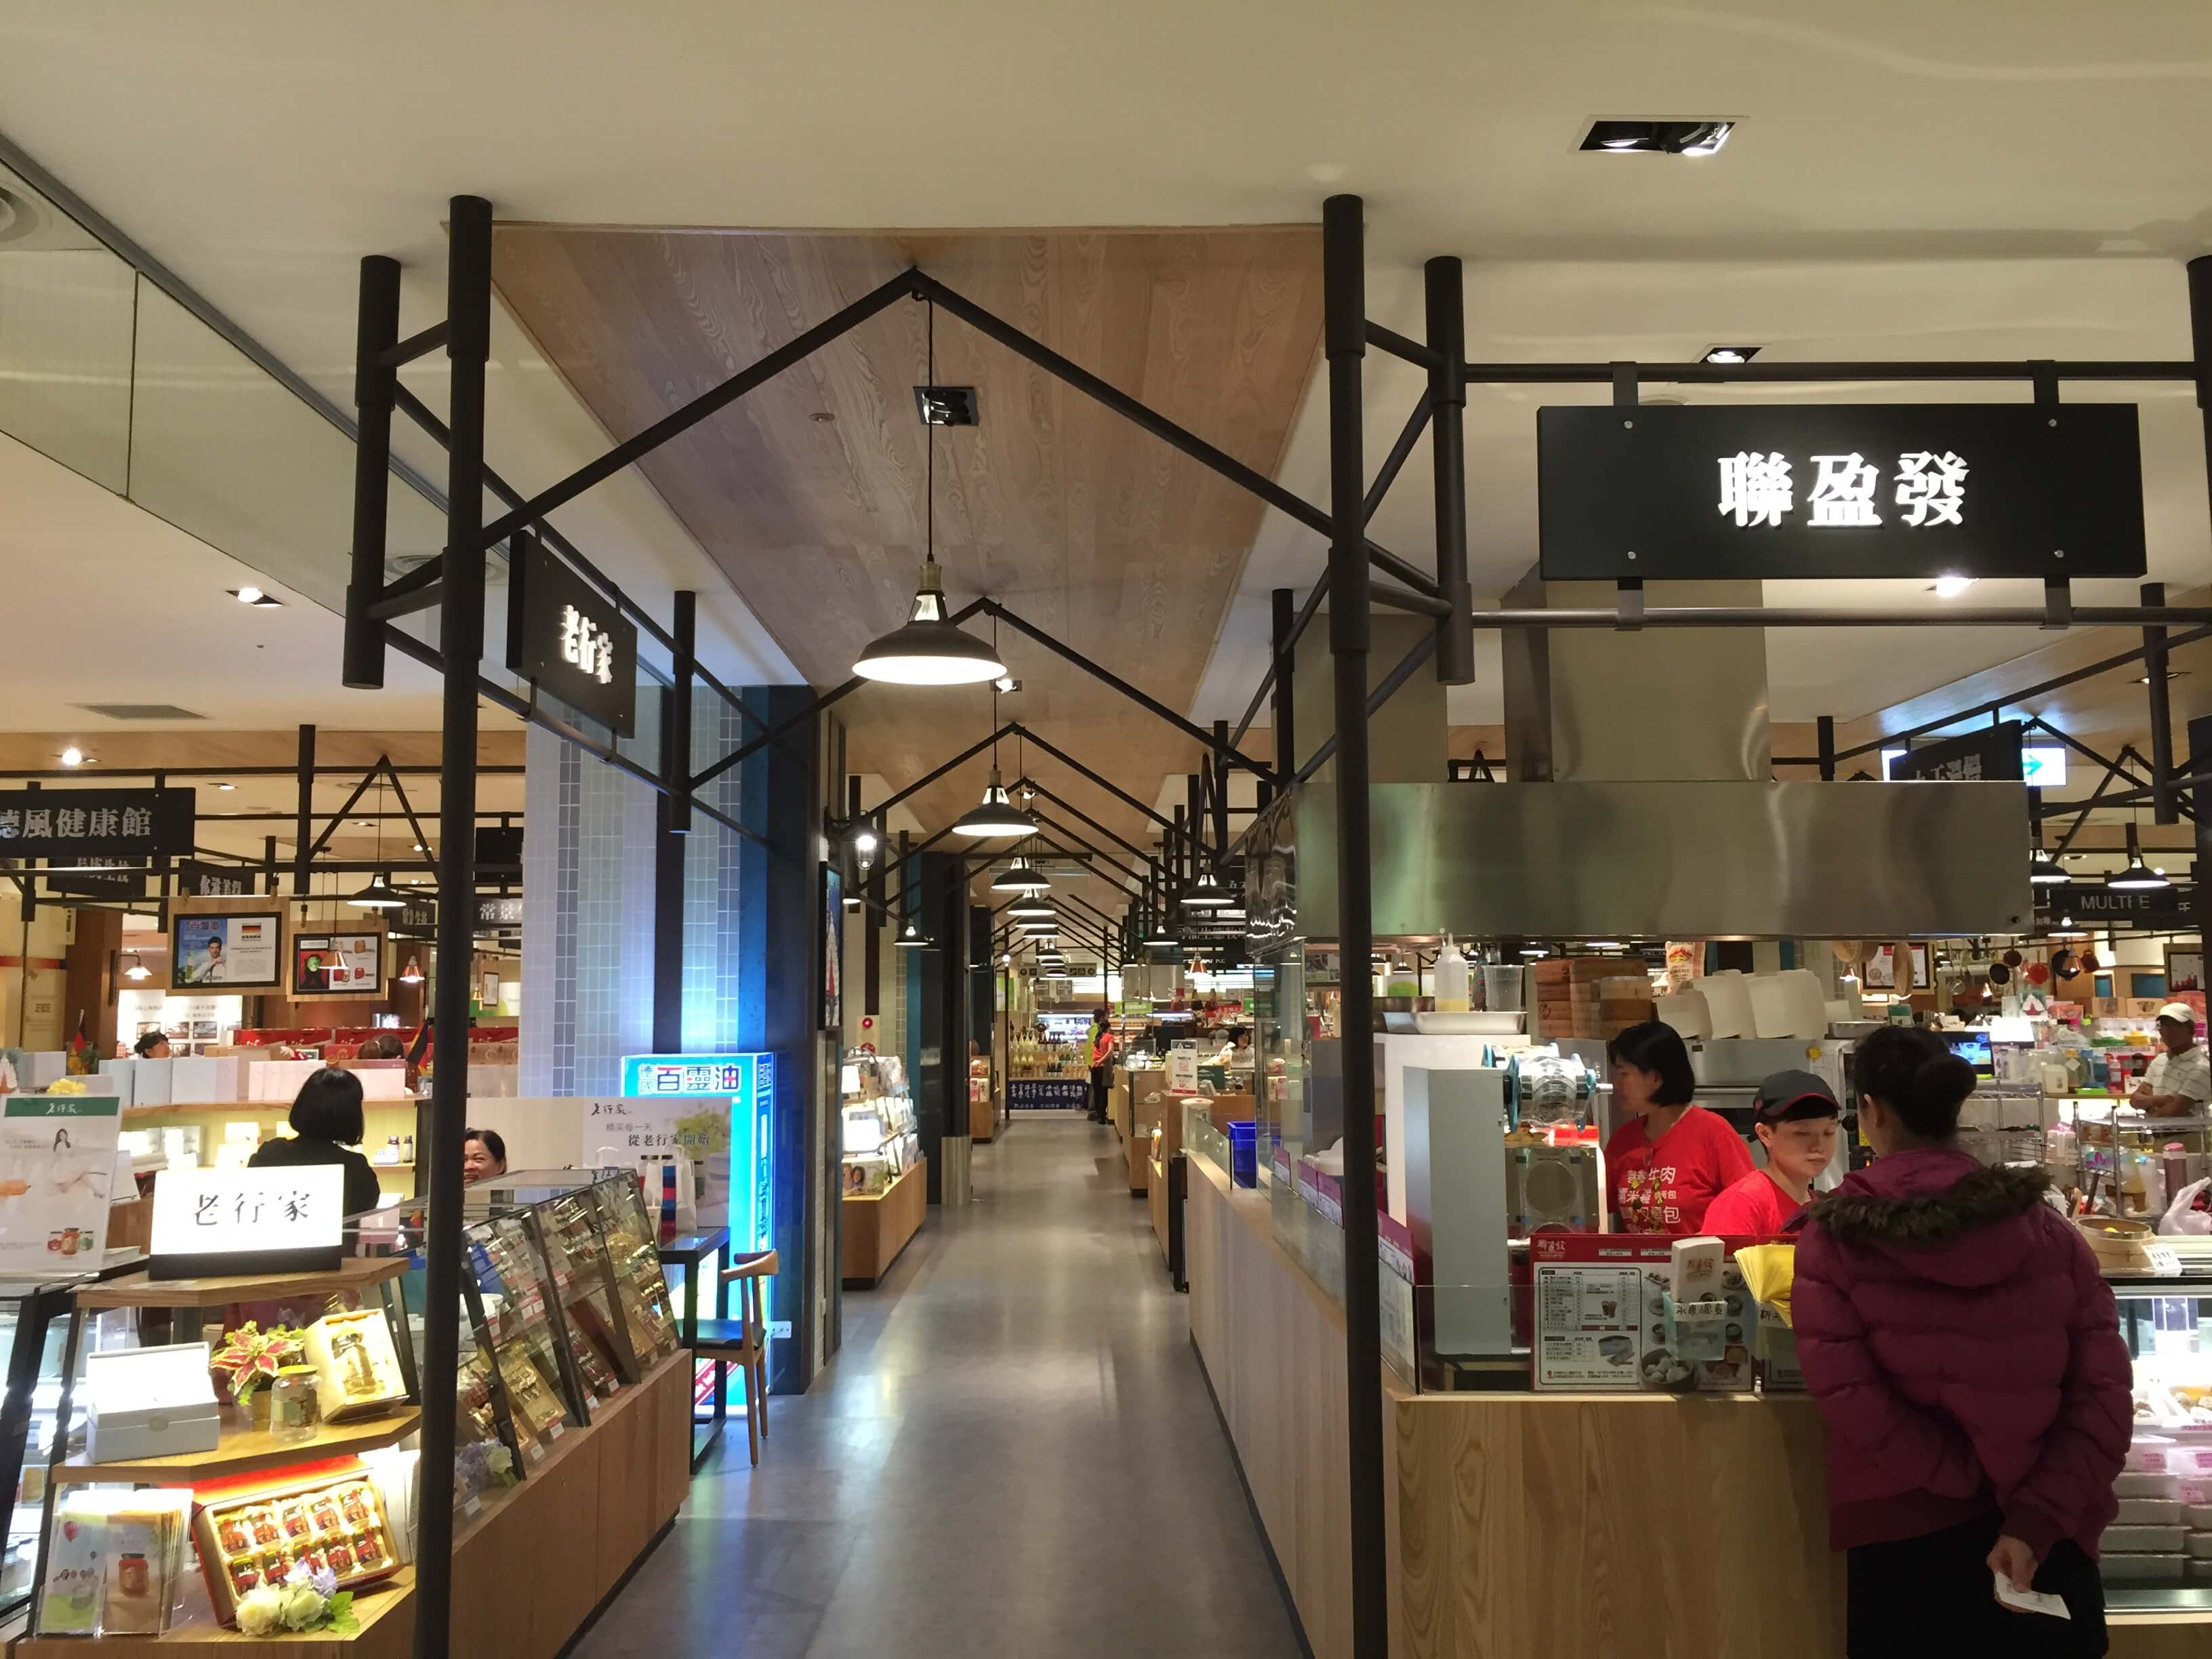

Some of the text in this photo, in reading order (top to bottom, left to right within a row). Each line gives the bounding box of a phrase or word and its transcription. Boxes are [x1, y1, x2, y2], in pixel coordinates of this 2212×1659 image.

[1717, 451, 1969, 527] 聯盈發
[561, 605, 613, 684] 老行家
[657, 1065, 739, 1091] 百靈油
[628, 1134, 710, 1147] 從老行家開始
[192, 1190, 310, 1226] 老行家
